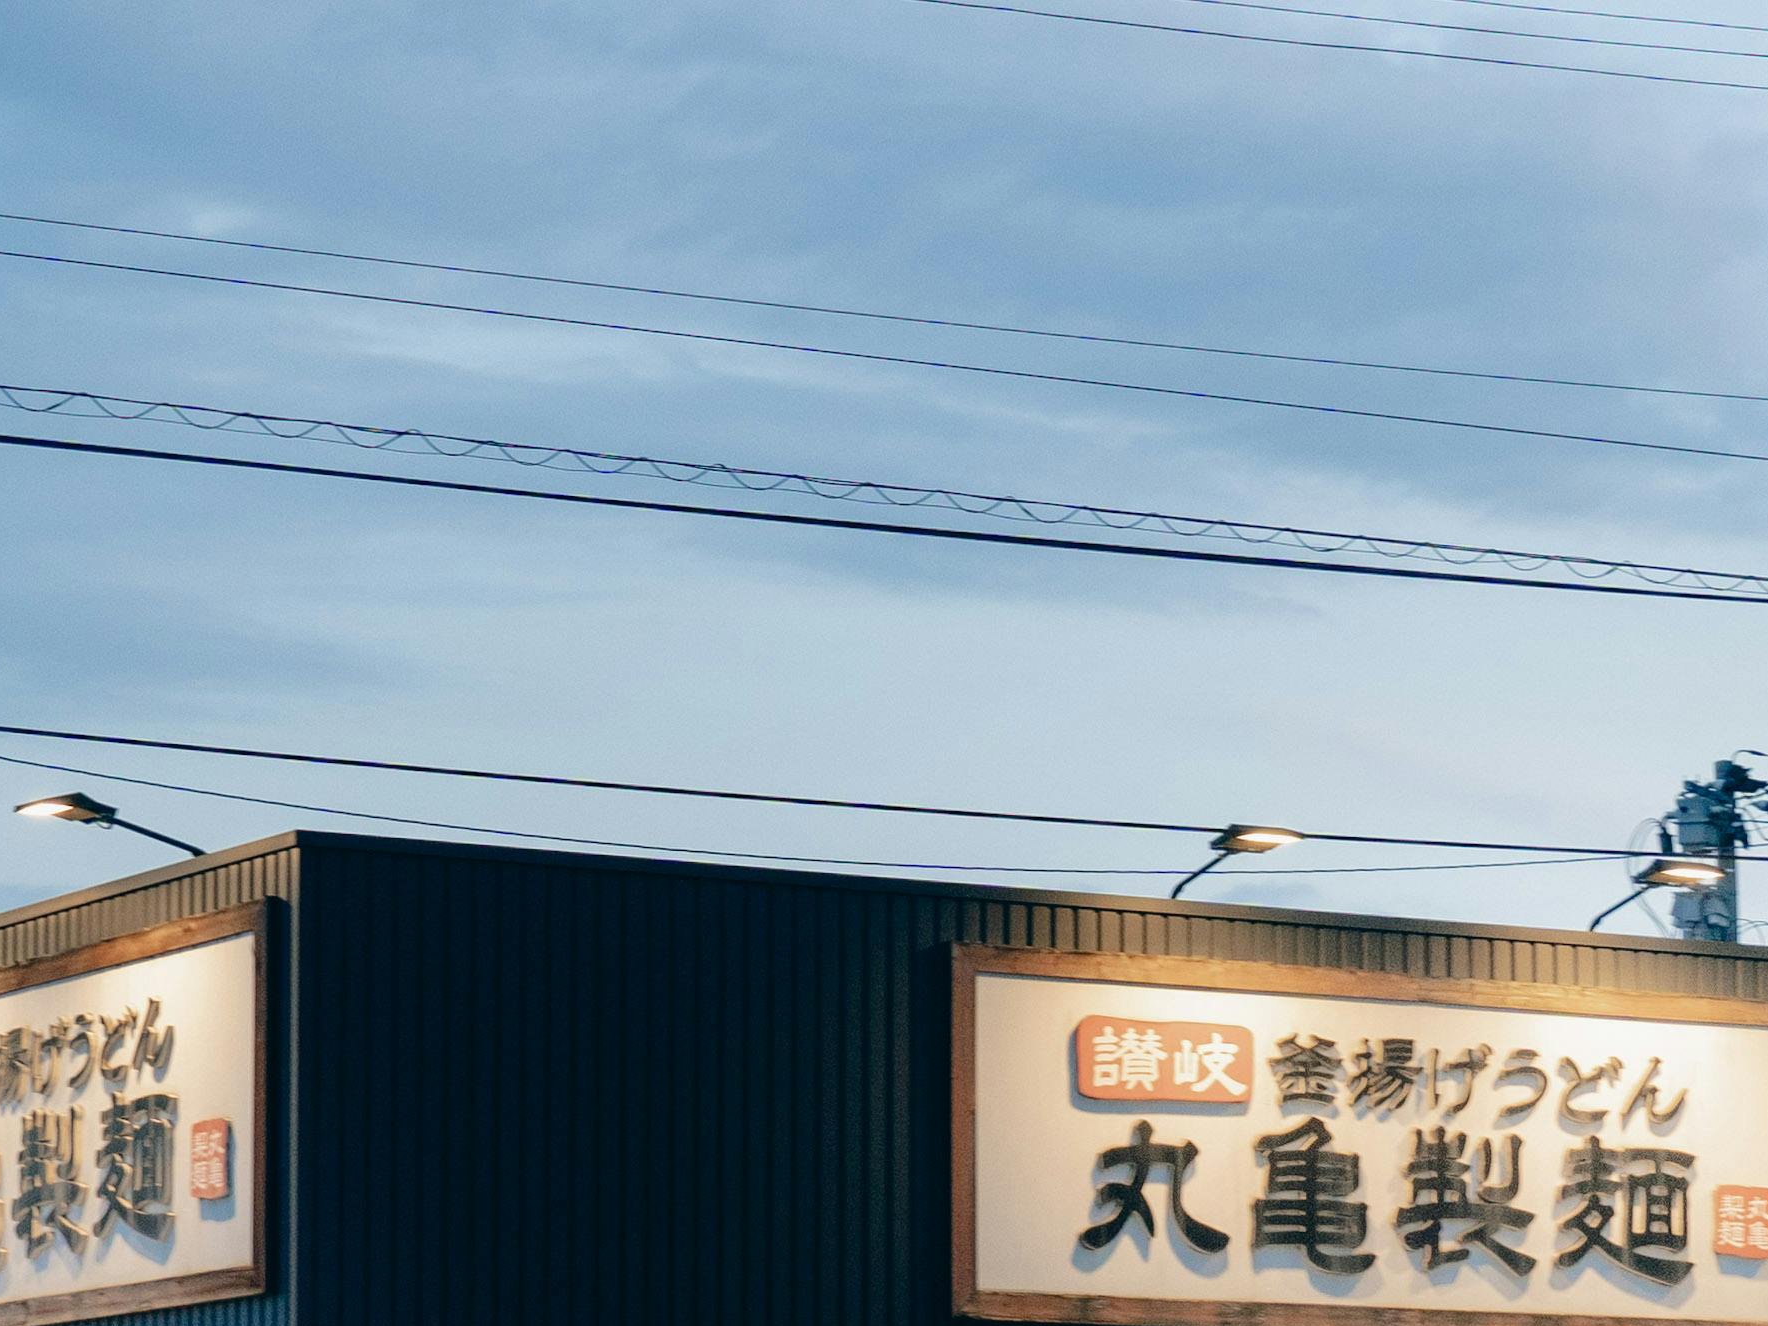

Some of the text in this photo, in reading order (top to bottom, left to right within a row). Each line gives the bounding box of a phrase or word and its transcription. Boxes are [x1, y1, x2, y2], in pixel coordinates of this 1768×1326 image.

[1090, 1025, 1687, 1130] 讃岐 釜揚げうどん
[1078, 1116, 1696, 1288] 丸亀製麺
